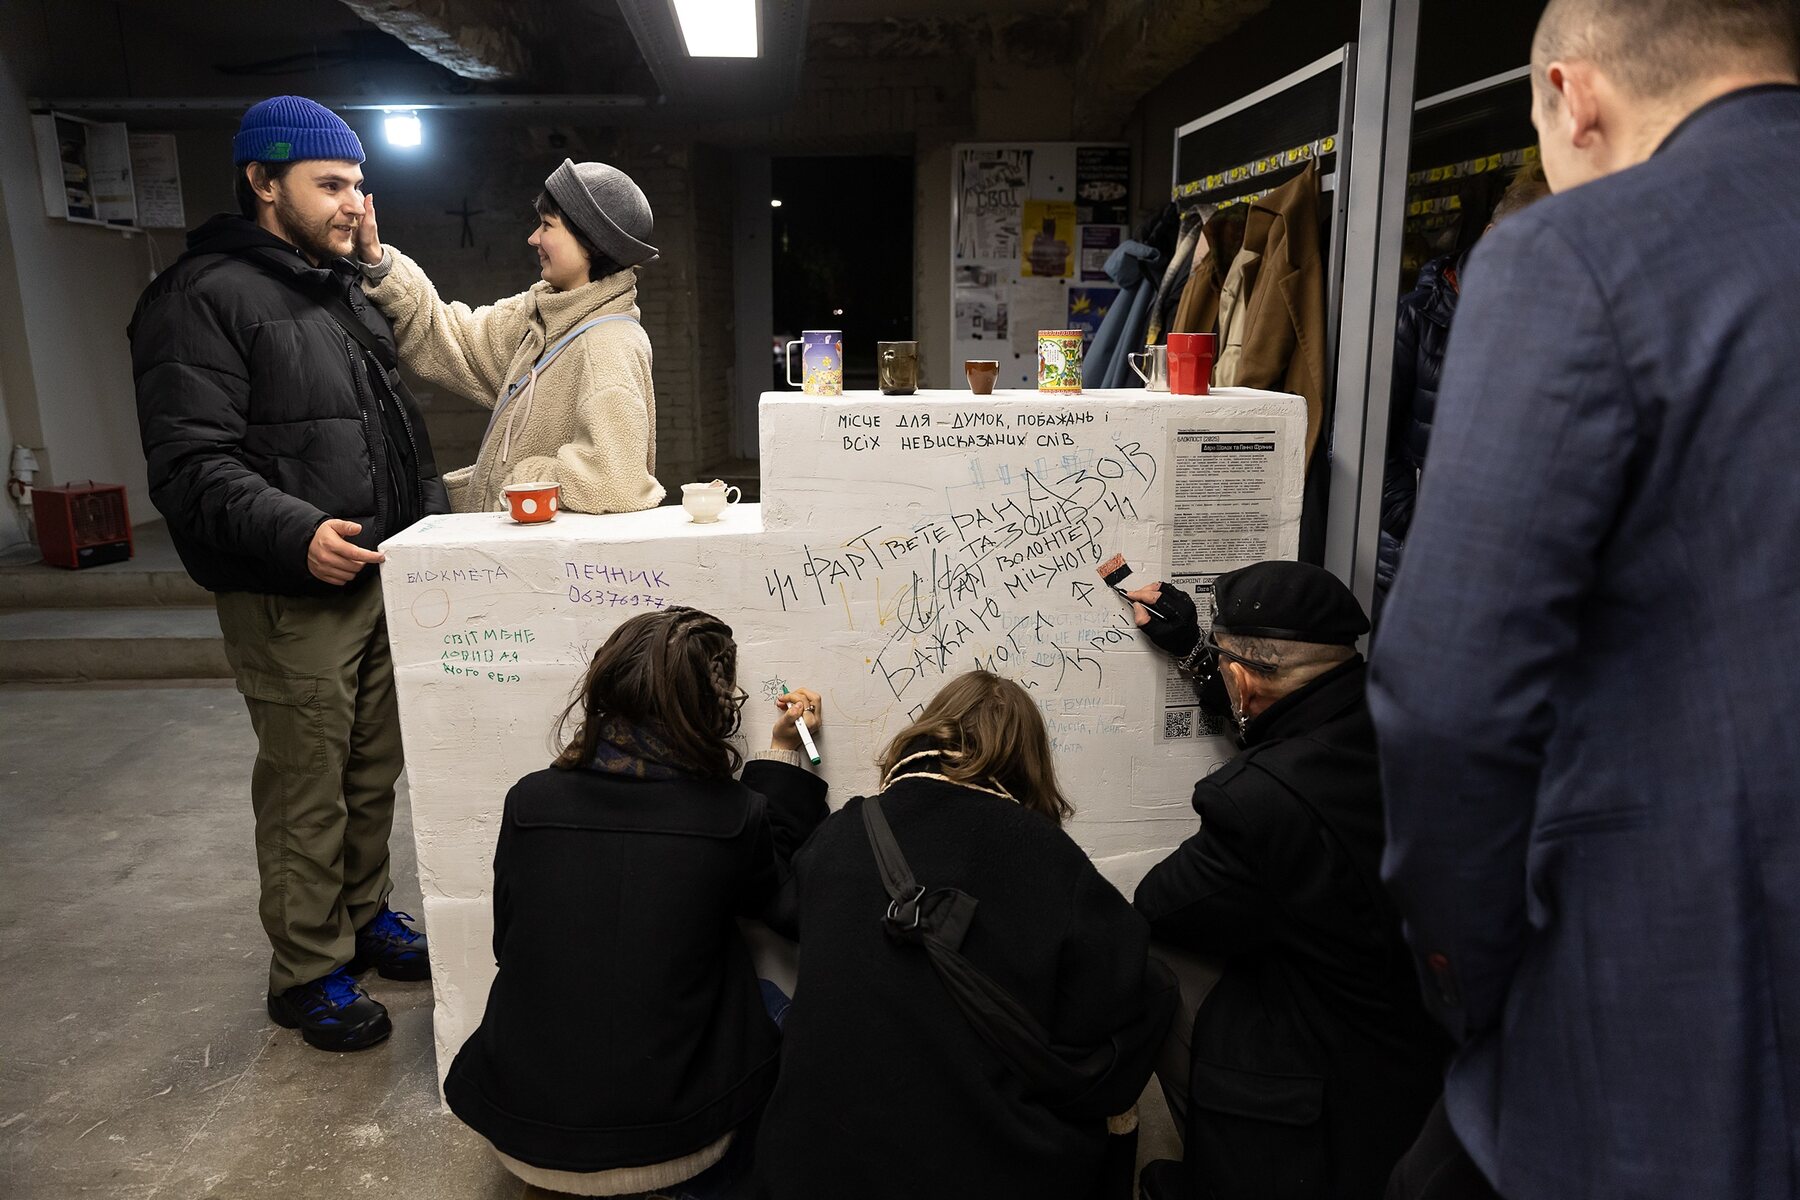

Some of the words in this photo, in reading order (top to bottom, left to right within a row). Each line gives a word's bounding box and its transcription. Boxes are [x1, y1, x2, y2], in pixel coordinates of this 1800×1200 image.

[895, 414, 931, 428] ДЛЯ
[1016, 411, 1094, 428] ПОБАЖАНЬ
[900, 432, 1026, 451] НЕВИСКАЗАНИХ
[802, 525, 885, 606] ФАРТ
[883, 497, 1028, 561] ВЕТЕРАН
[564, 562, 670, 589] ПЕЧНИК
